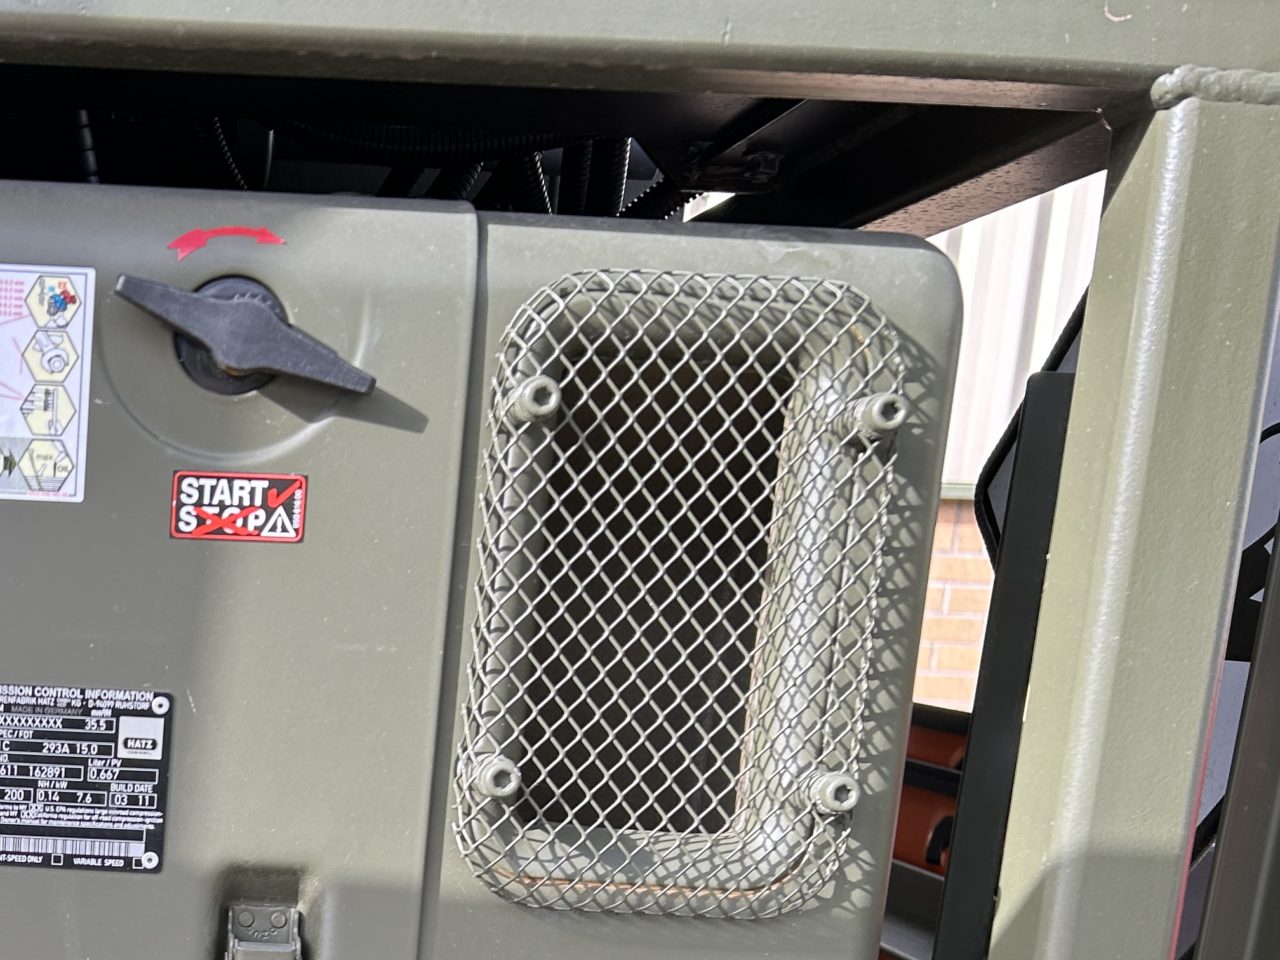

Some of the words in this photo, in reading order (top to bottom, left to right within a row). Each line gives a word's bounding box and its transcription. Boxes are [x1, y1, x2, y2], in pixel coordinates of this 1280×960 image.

[180, 477, 269, 506] START
[34, 686, 83, 699] CONTROL
[85, 689, 154, 702] INFORMATION
[37, 697, 55, 706] HATZ
[11, 705, 33, 714] MADE
[34, 706, 43, 714] IN
[44, 707, 82, 716] GERMANY
[42, 742, 70, 754] 293A
[127, 738, 153, 749] HATZ
[111, 759, 123, 768] PV
[29, 765, 65, 778] 162891
[110, 783, 133, 792] BUILD
[134, 784, 153, 793] DATE
[4, 789, 24, 801] 200
[114, 795, 128, 806] 03
[138, 795, 150, 807] 11
[104, 859, 124, 868] SPEED
